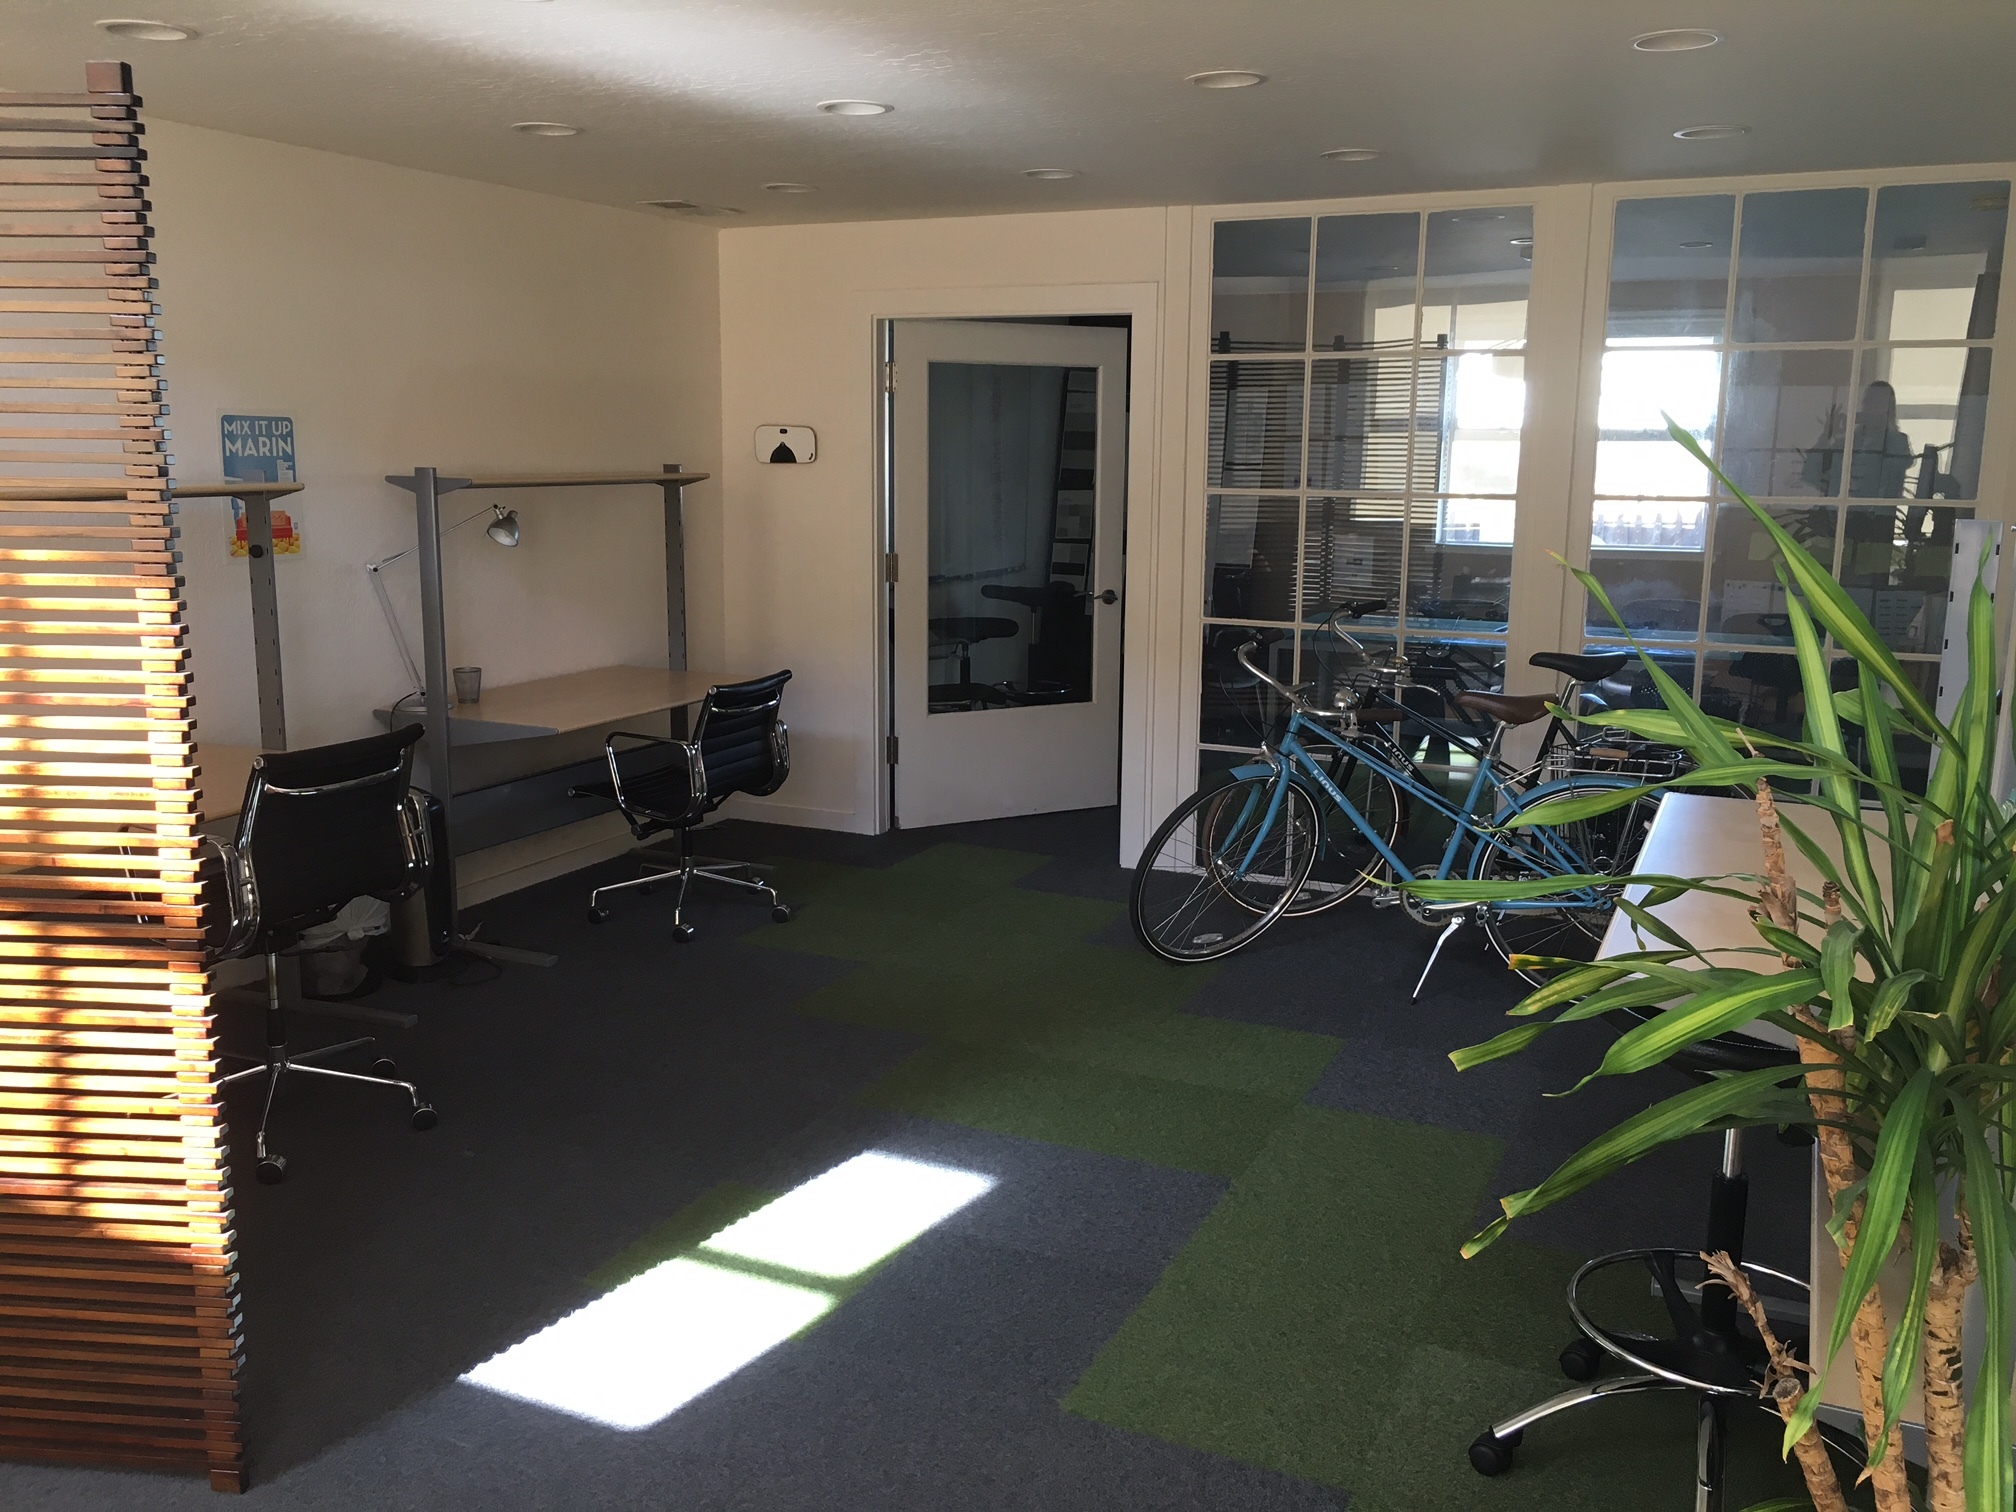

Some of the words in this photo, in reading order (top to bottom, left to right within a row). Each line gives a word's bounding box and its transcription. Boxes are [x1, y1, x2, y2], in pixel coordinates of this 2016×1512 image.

[224, 420, 251, 434] MIX
[255, 421, 268, 434] IT
[272, 421, 291, 435] UP
[225, 437, 292, 457] MARIN
